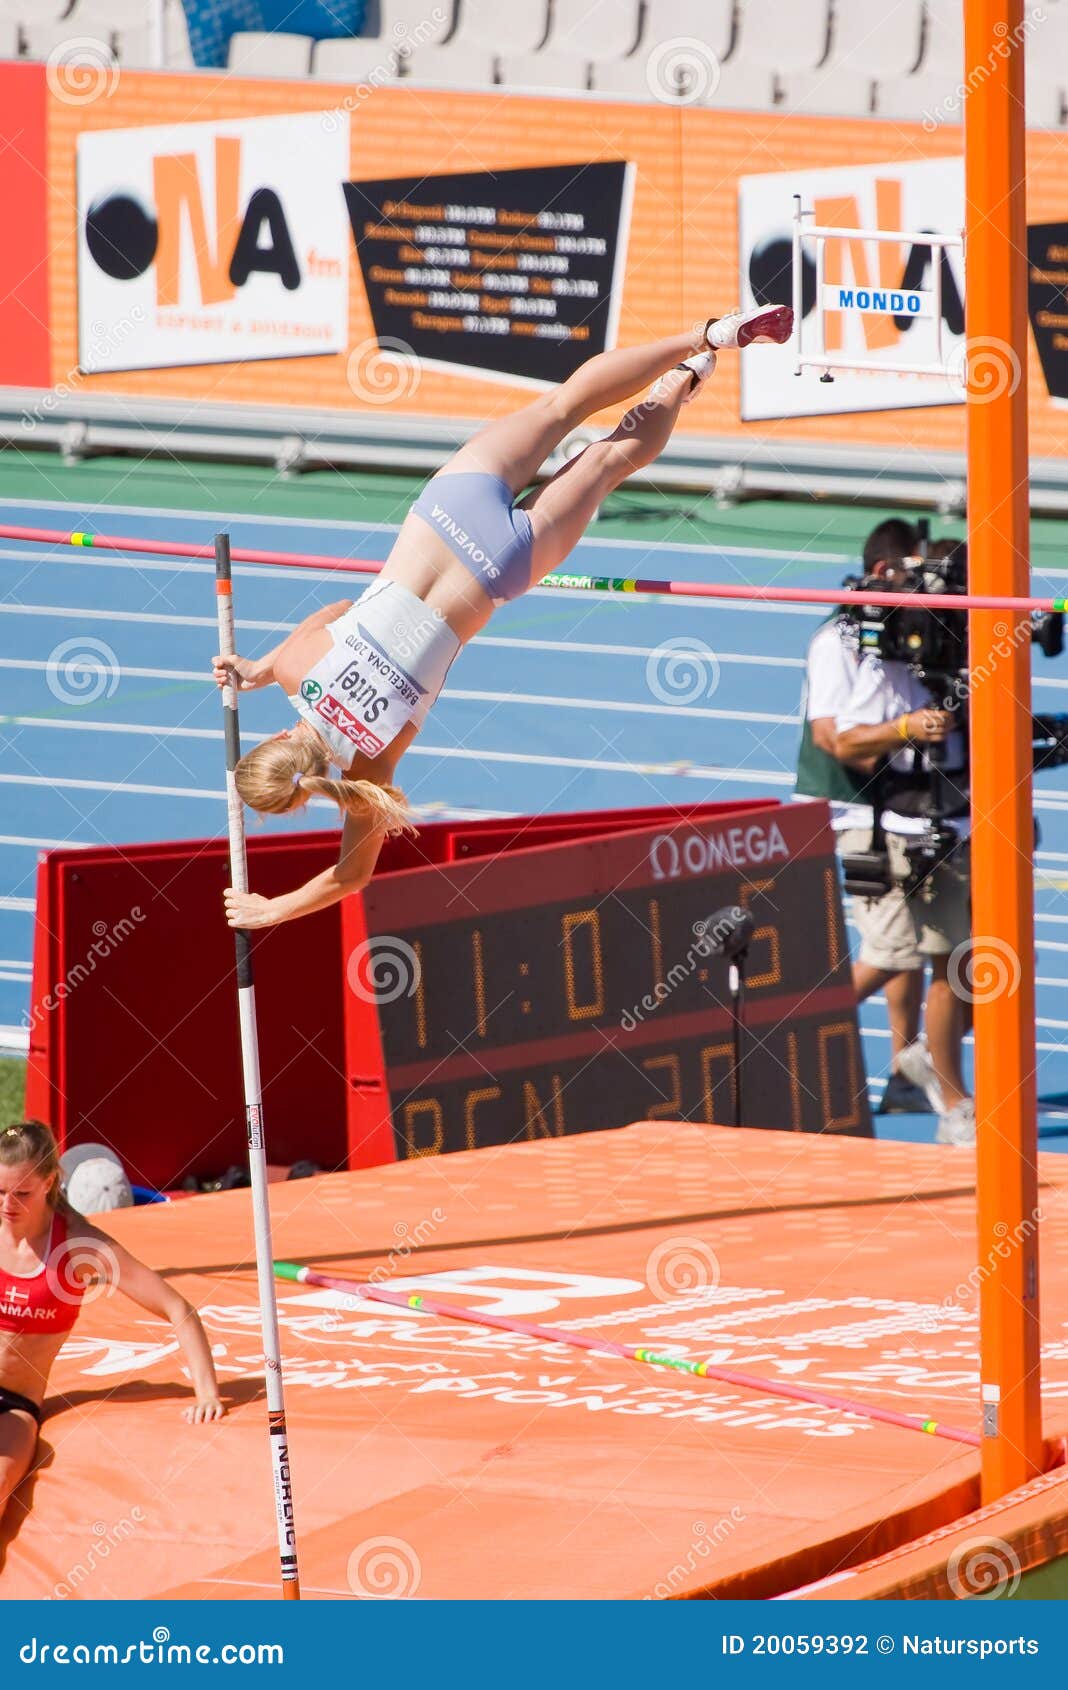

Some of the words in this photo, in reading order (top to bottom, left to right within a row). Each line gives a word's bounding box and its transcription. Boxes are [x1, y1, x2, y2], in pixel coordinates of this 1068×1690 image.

[86, 136, 301, 306] ONA
[839, 290, 921, 313] MONDO
[430, 503, 500, 580] SLOVENIJA
[329, 660, 389, 723] Sutej
[367, 651, 419, 706] BARCELONA
[319, 698, 382, 754] SPAR
[683, 822, 789, 873] OMEGA
[278, 1444, 296, 1546] NORDIC
